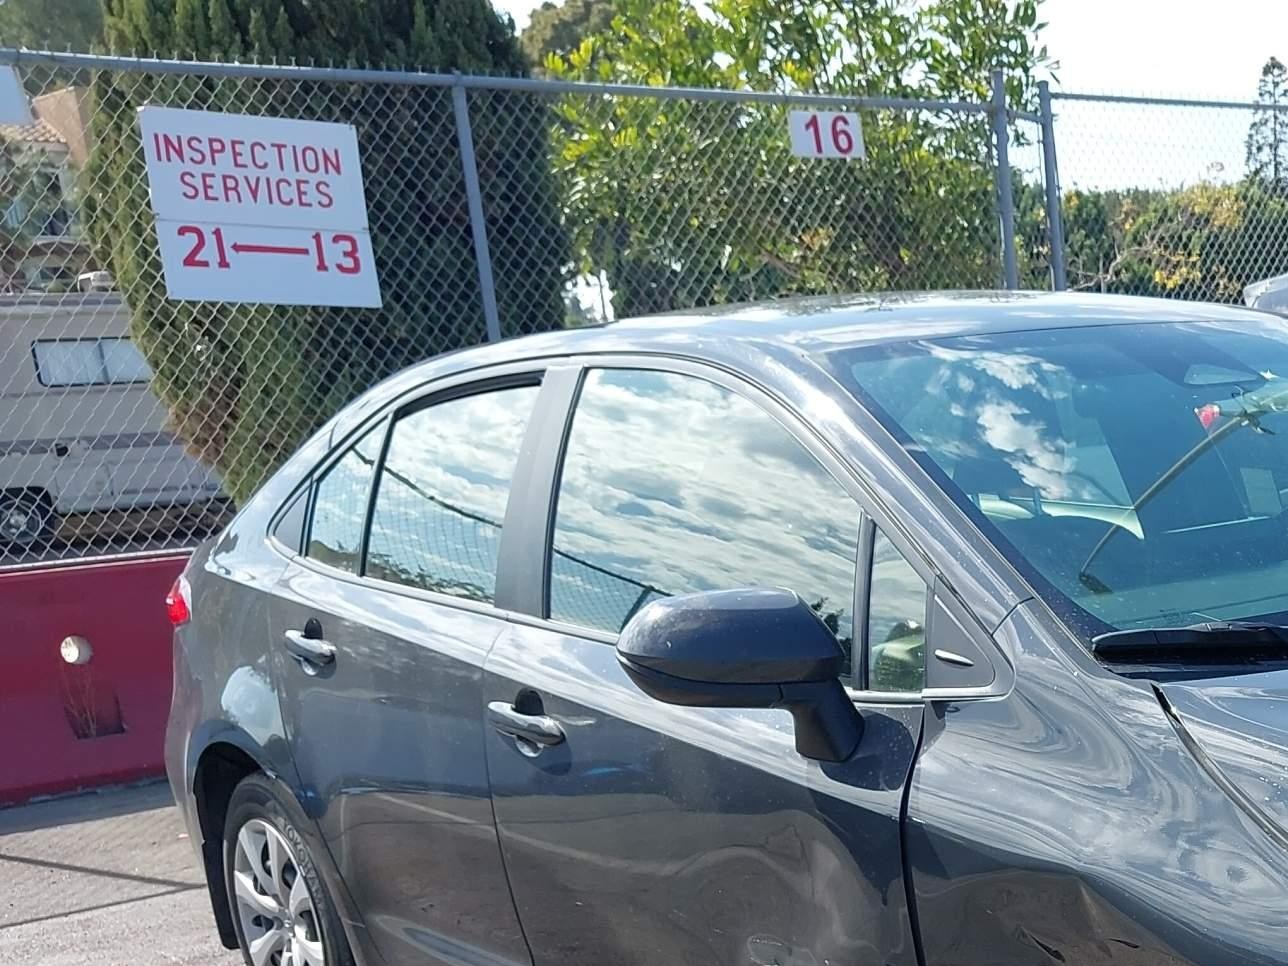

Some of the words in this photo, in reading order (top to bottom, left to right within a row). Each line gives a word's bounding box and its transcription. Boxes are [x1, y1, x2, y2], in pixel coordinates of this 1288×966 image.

[153, 132, 342, 176] INSPECTION
[804, 113, 854, 156] 16
[179, 171, 334, 209] SERVICES
[176, 225, 231, 269] 21
[311, 231, 362, 275] 13
